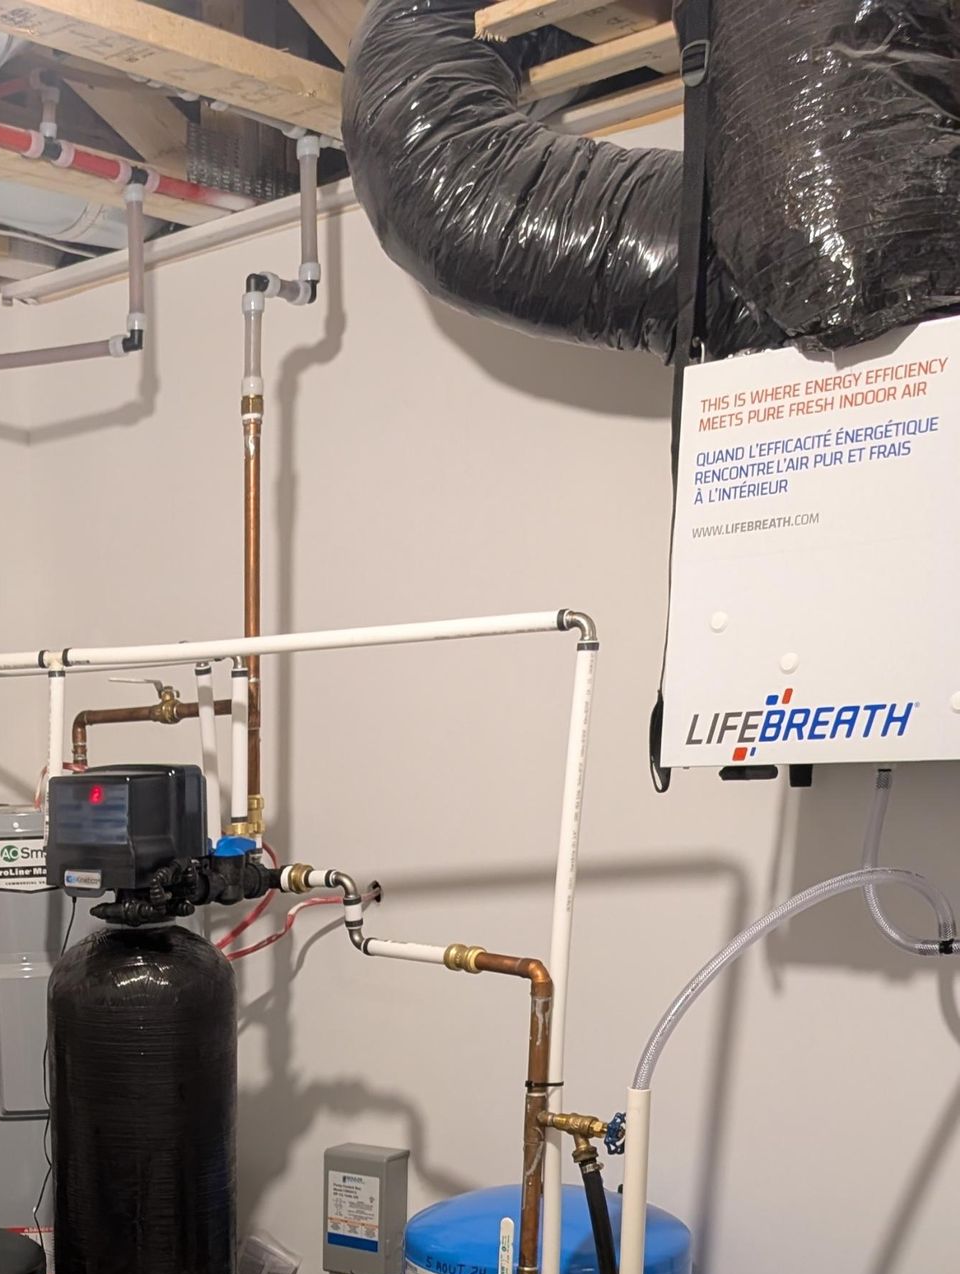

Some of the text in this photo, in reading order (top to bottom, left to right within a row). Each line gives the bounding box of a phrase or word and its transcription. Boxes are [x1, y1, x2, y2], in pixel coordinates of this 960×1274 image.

[698, 381, 927, 432] MEETS PURE FRESH INDOOR AIR
[701, 357, 948, 413] THIS IS WHERE ENERGY EFFICIENCY
[695, 441, 911, 485] RENCONTRE L'AIR PUR ET FRAIS
[696, 416, 939, 467] QUAND L'EFFICACITÉ ÉNERGÉTIQUE
[694, 479, 788, 505] À L'INTÉRIEUR
[692, 513, 820, 539] WWW.LIFEBREATH.COM
[685, 702, 913, 745] LIFEBREATH
